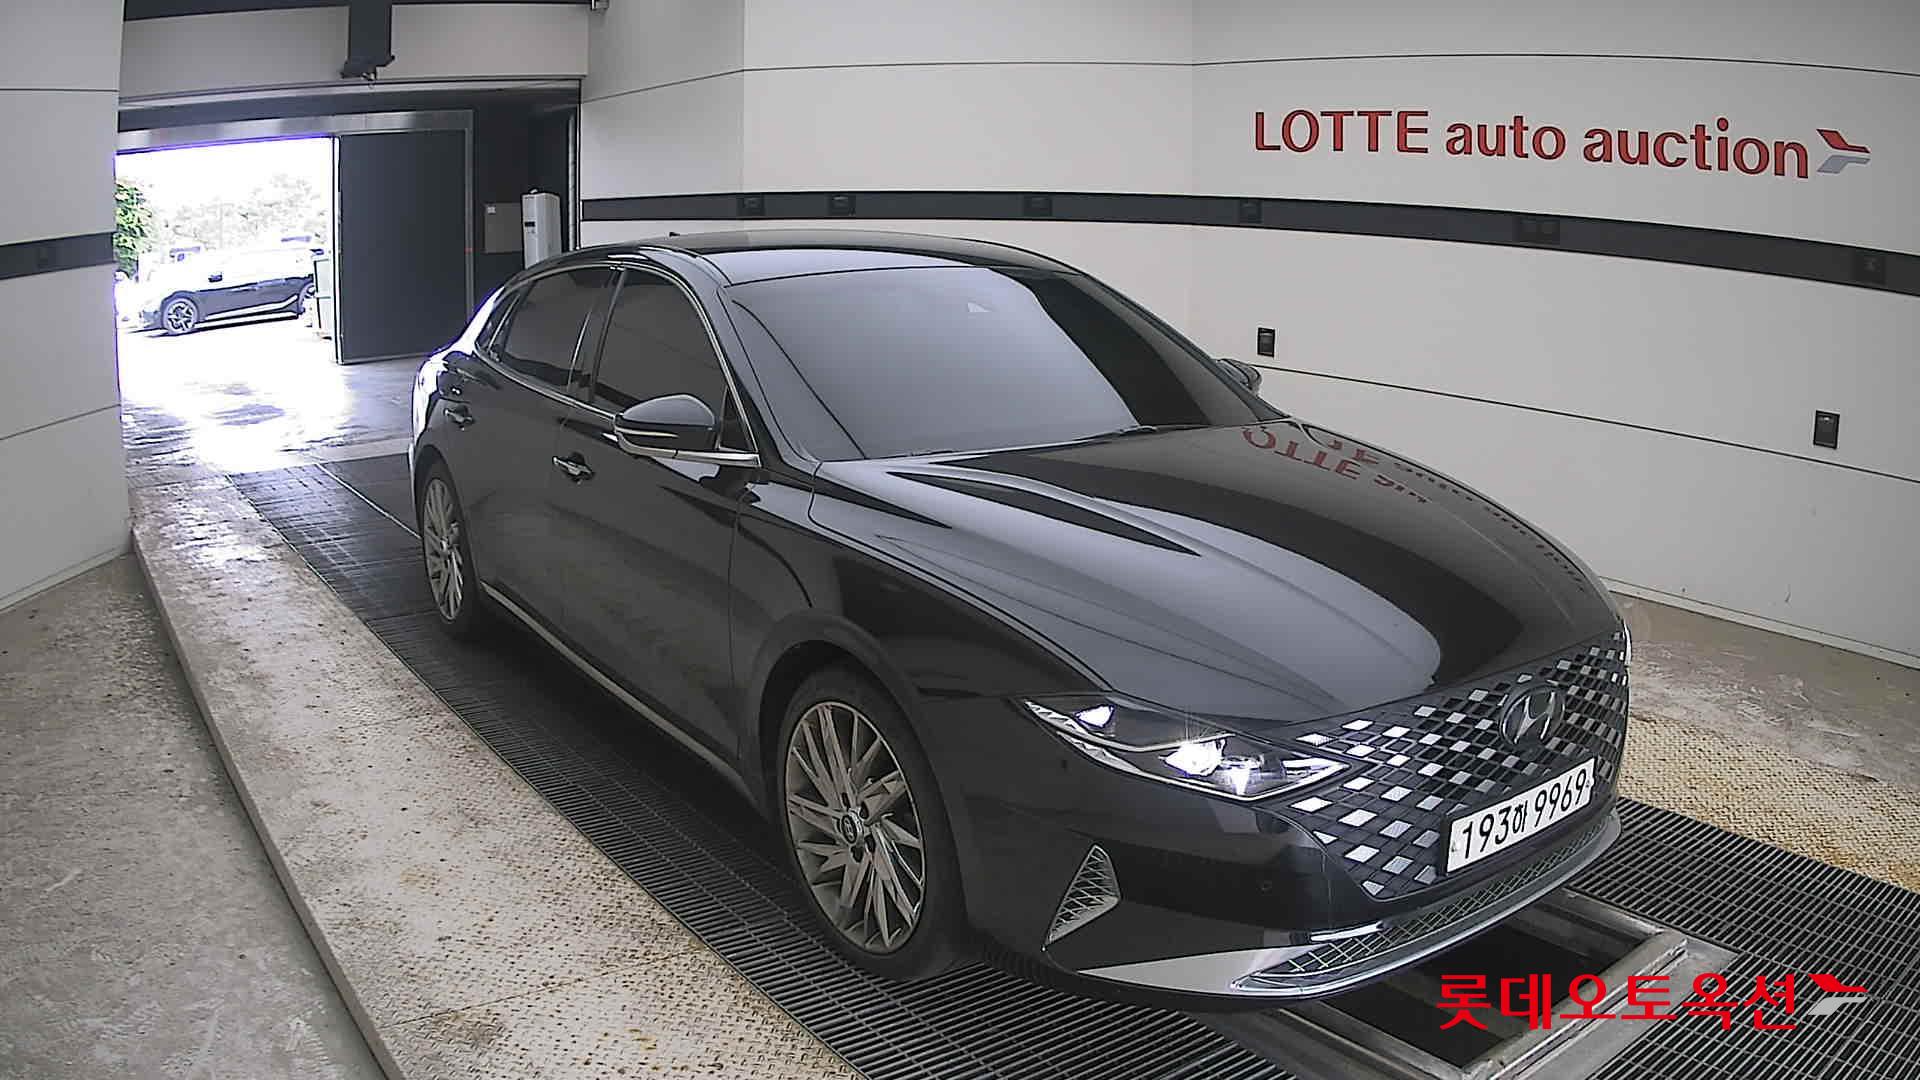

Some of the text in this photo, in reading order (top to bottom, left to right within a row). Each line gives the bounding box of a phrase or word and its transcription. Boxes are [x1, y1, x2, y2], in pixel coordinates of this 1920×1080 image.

[1255, 110, 1809, 179] LOTTE auto auction
[1534, 768, 1587, 828] 9969
